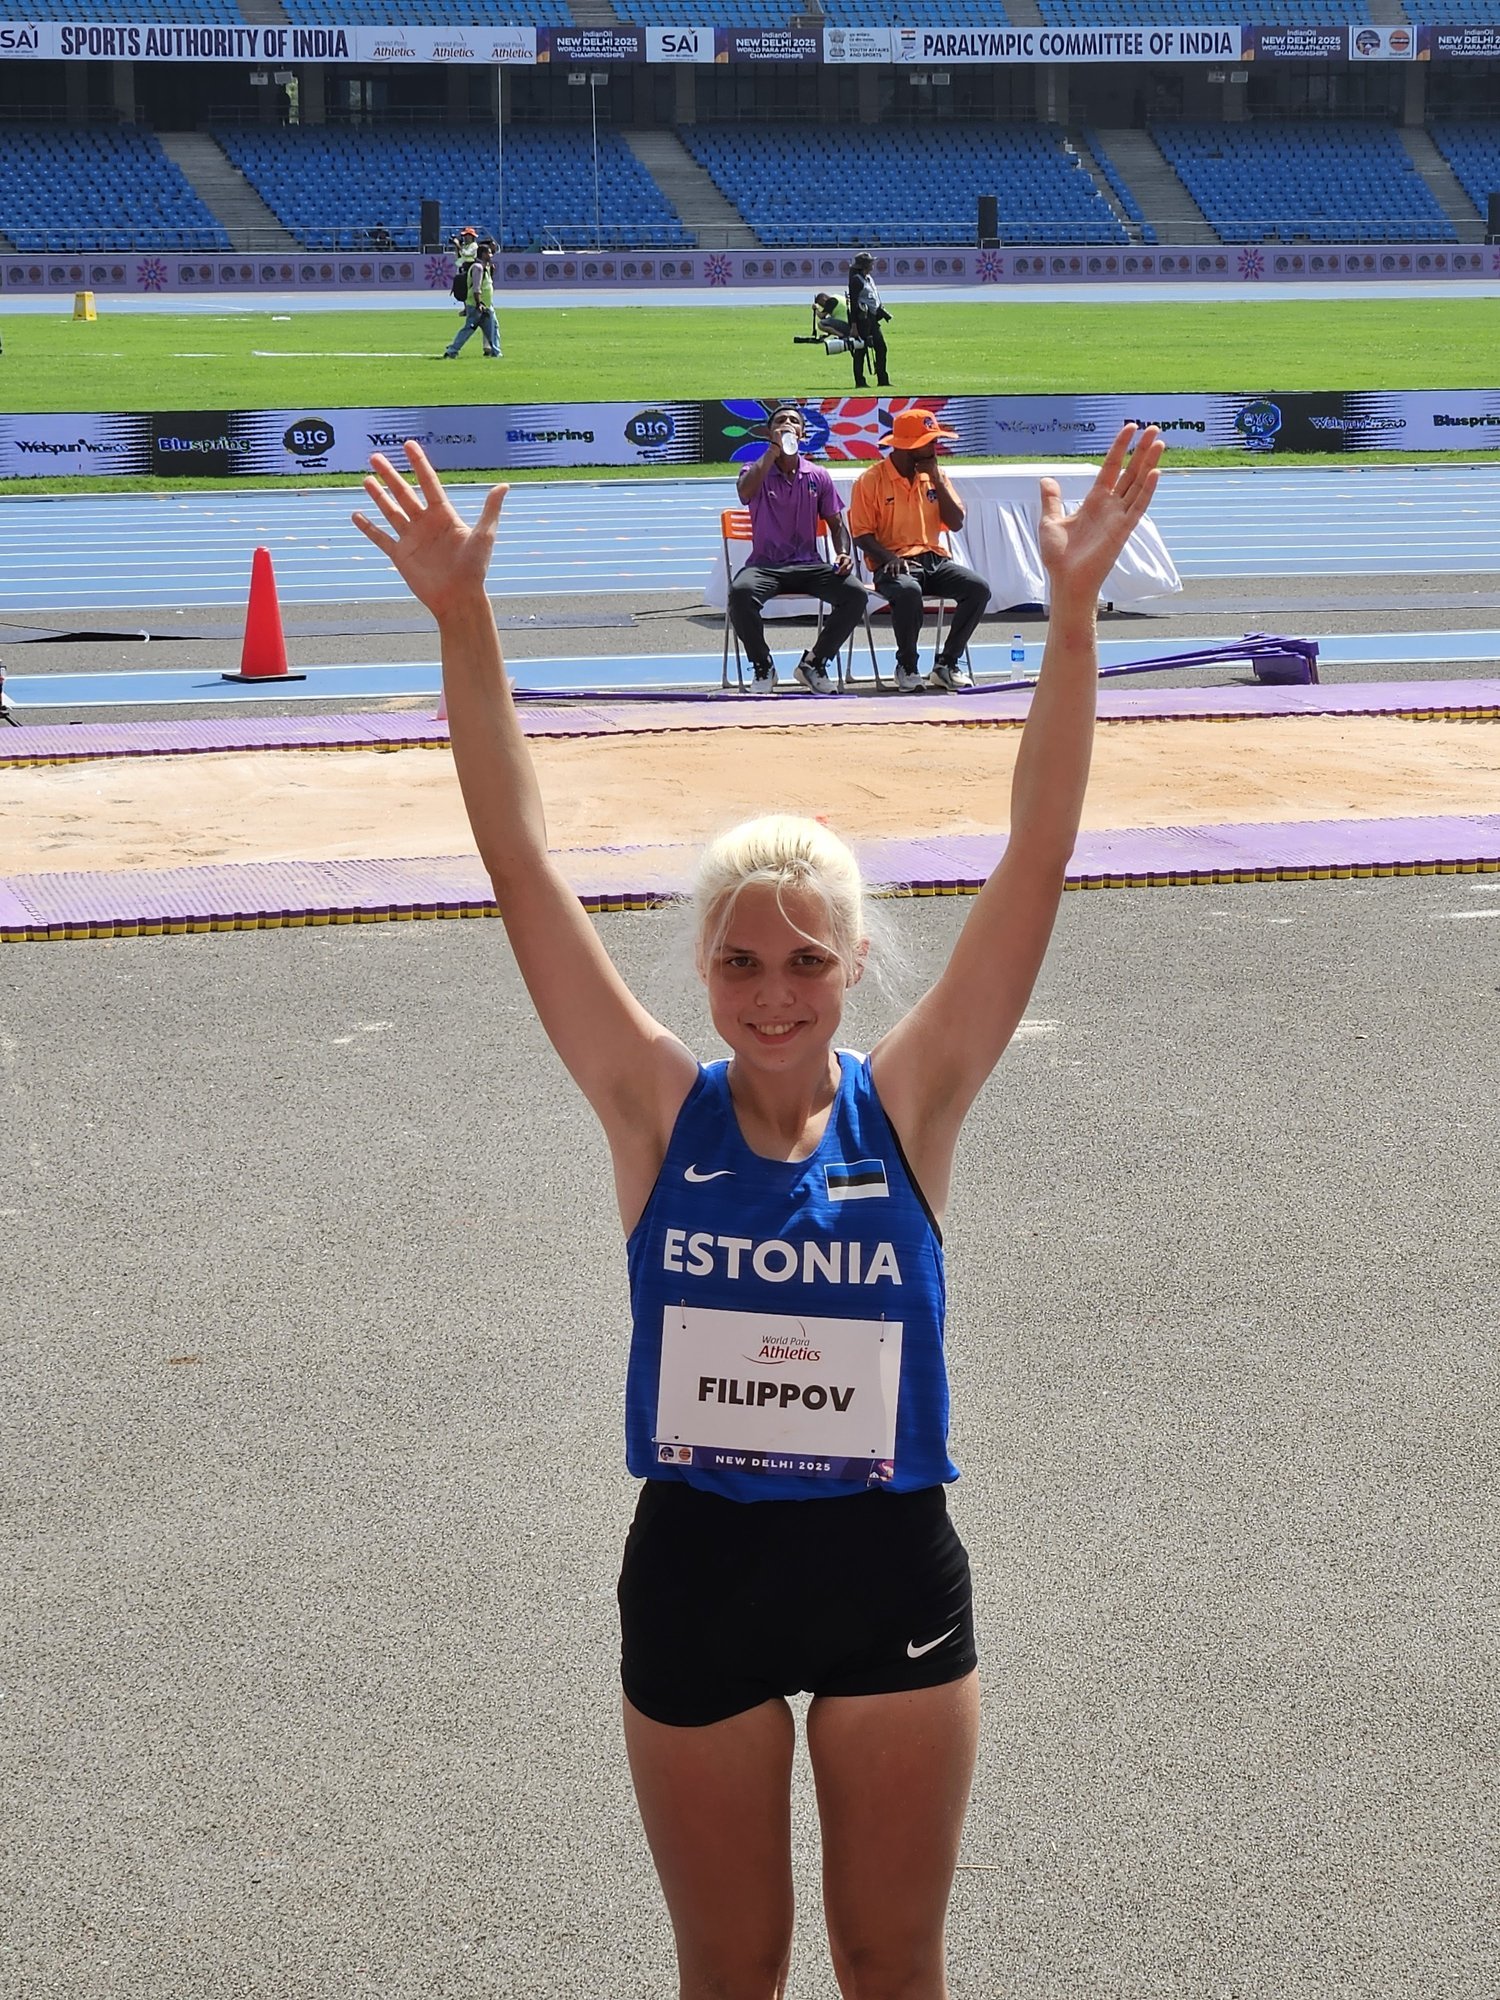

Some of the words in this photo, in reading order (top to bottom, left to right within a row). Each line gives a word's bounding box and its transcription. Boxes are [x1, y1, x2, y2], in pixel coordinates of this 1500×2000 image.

[0, 29, 38, 48] SAI
[582, 30, 613, 38] IndianOil
[1261, 36, 1286, 44] NEW
[1287, 36, 1317, 44] DELHI
[1318, 36, 1341, 44] 2025
[1438, 36, 1463, 44] NEW
[1464, 36, 1493, 44] DELHI
[61, 26, 140, 56] SPORTS
[145, 27, 259, 57] AUTHORITY
[263, 29, 288, 58] OF
[293, 29, 349, 58] INDIA
[556, 38, 582, 46] NEW
[582, 38, 613, 46] DELHI
[614, 38, 638, 46] 2025
[661, 35, 698, 53] SAI
[735, 39, 761, 47] NEW
[761, 39, 792, 47] DELHI
[793, 39, 817, 47] 2025
[923, 33, 1033, 56] PARALYMPIC
[1039, 33, 1143, 56] COMMITTEE
[1149, 32, 1174, 55] OF
[1180, 31, 1233, 55] INDIA
[373, 47, 416, 57] Athletics
[432, 48, 475, 58] Athletics
[491, 48, 533, 58] Athletics
[1433, 414, 1500, 428] Blusprin
[158, 437, 252, 453] Bluspring
[293, 430, 328, 445] BIG
[14, 440, 81, 456] Welspun
[663, 1228, 903, 1286] ESTONIA
[762, 1335, 788, 1345] World
[789, 1337, 810, 1346] Para
[758, 1345, 821, 1362] Athletics
[698, 1376, 855, 1412] FILIPPOV
[715, 1455, 746, 1466] NEW
[751, 1457, 794, 1469] DELHI
[798, 1461, 831, 1471] 2025
